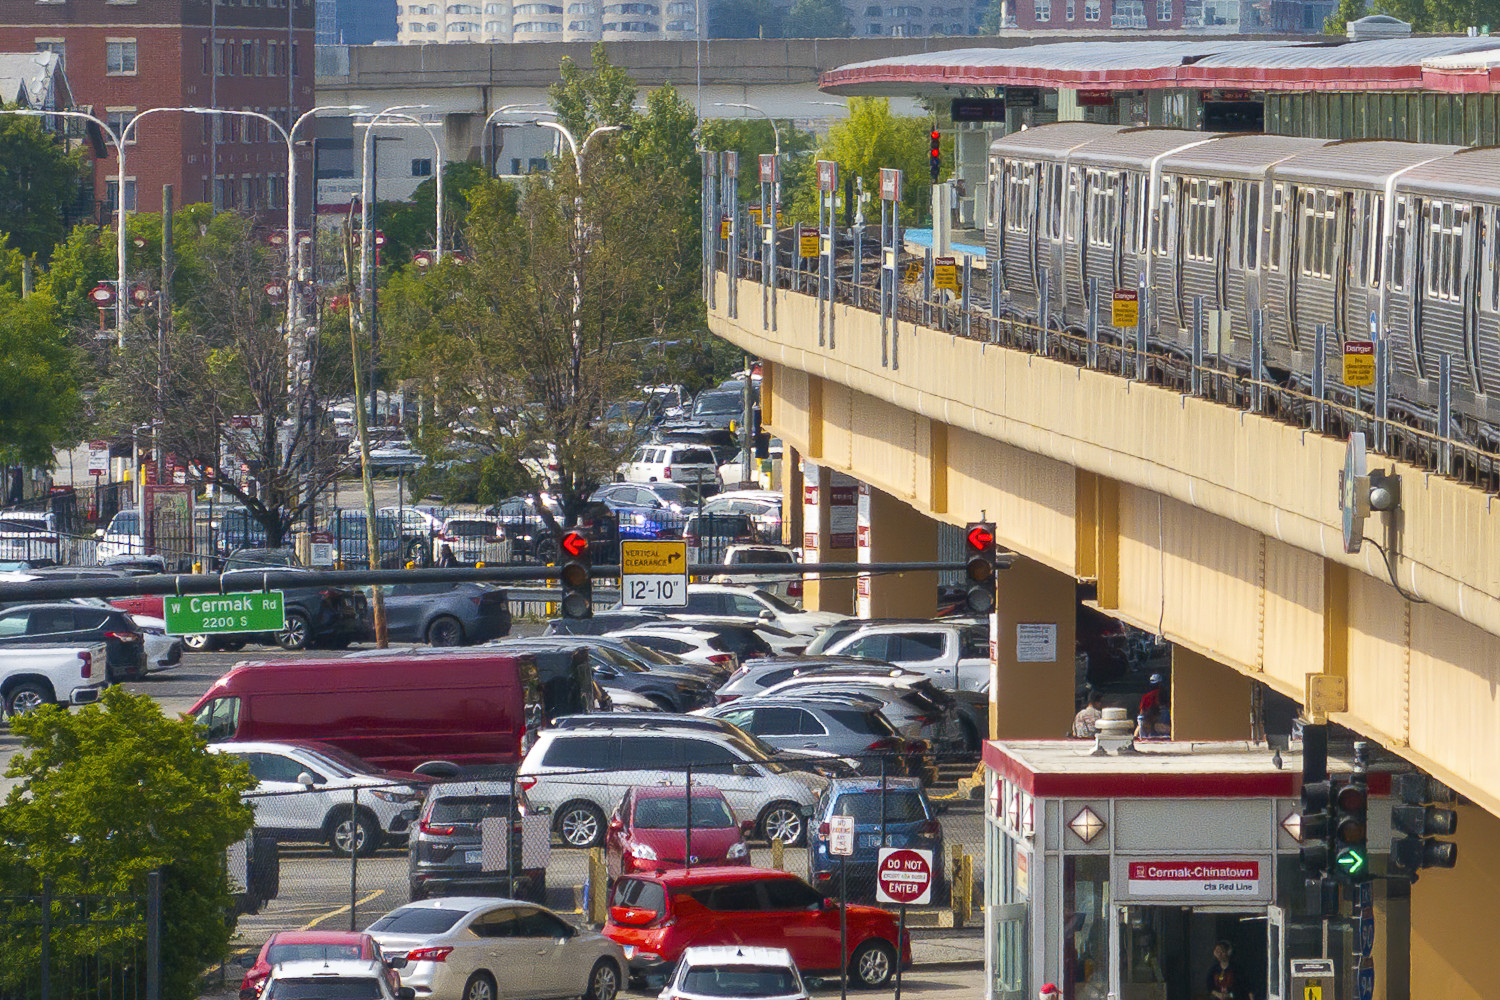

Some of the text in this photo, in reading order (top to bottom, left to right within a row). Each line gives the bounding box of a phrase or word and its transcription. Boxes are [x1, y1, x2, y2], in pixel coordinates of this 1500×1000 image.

[1346, 345, 1372, 353] Danger
[171, 596, 277, 613] W Cermak Rd
[203, 616, 248, 628] 2200 S
[887, 859, 922, 870] DO NOT
[1148, 866, 1254, 878] Cermak-Chinatown
[889, 882, 918, 894] ENTER
[1219, 883, 1234, 891] Red
[1236, 883, 1253, 891] Line
